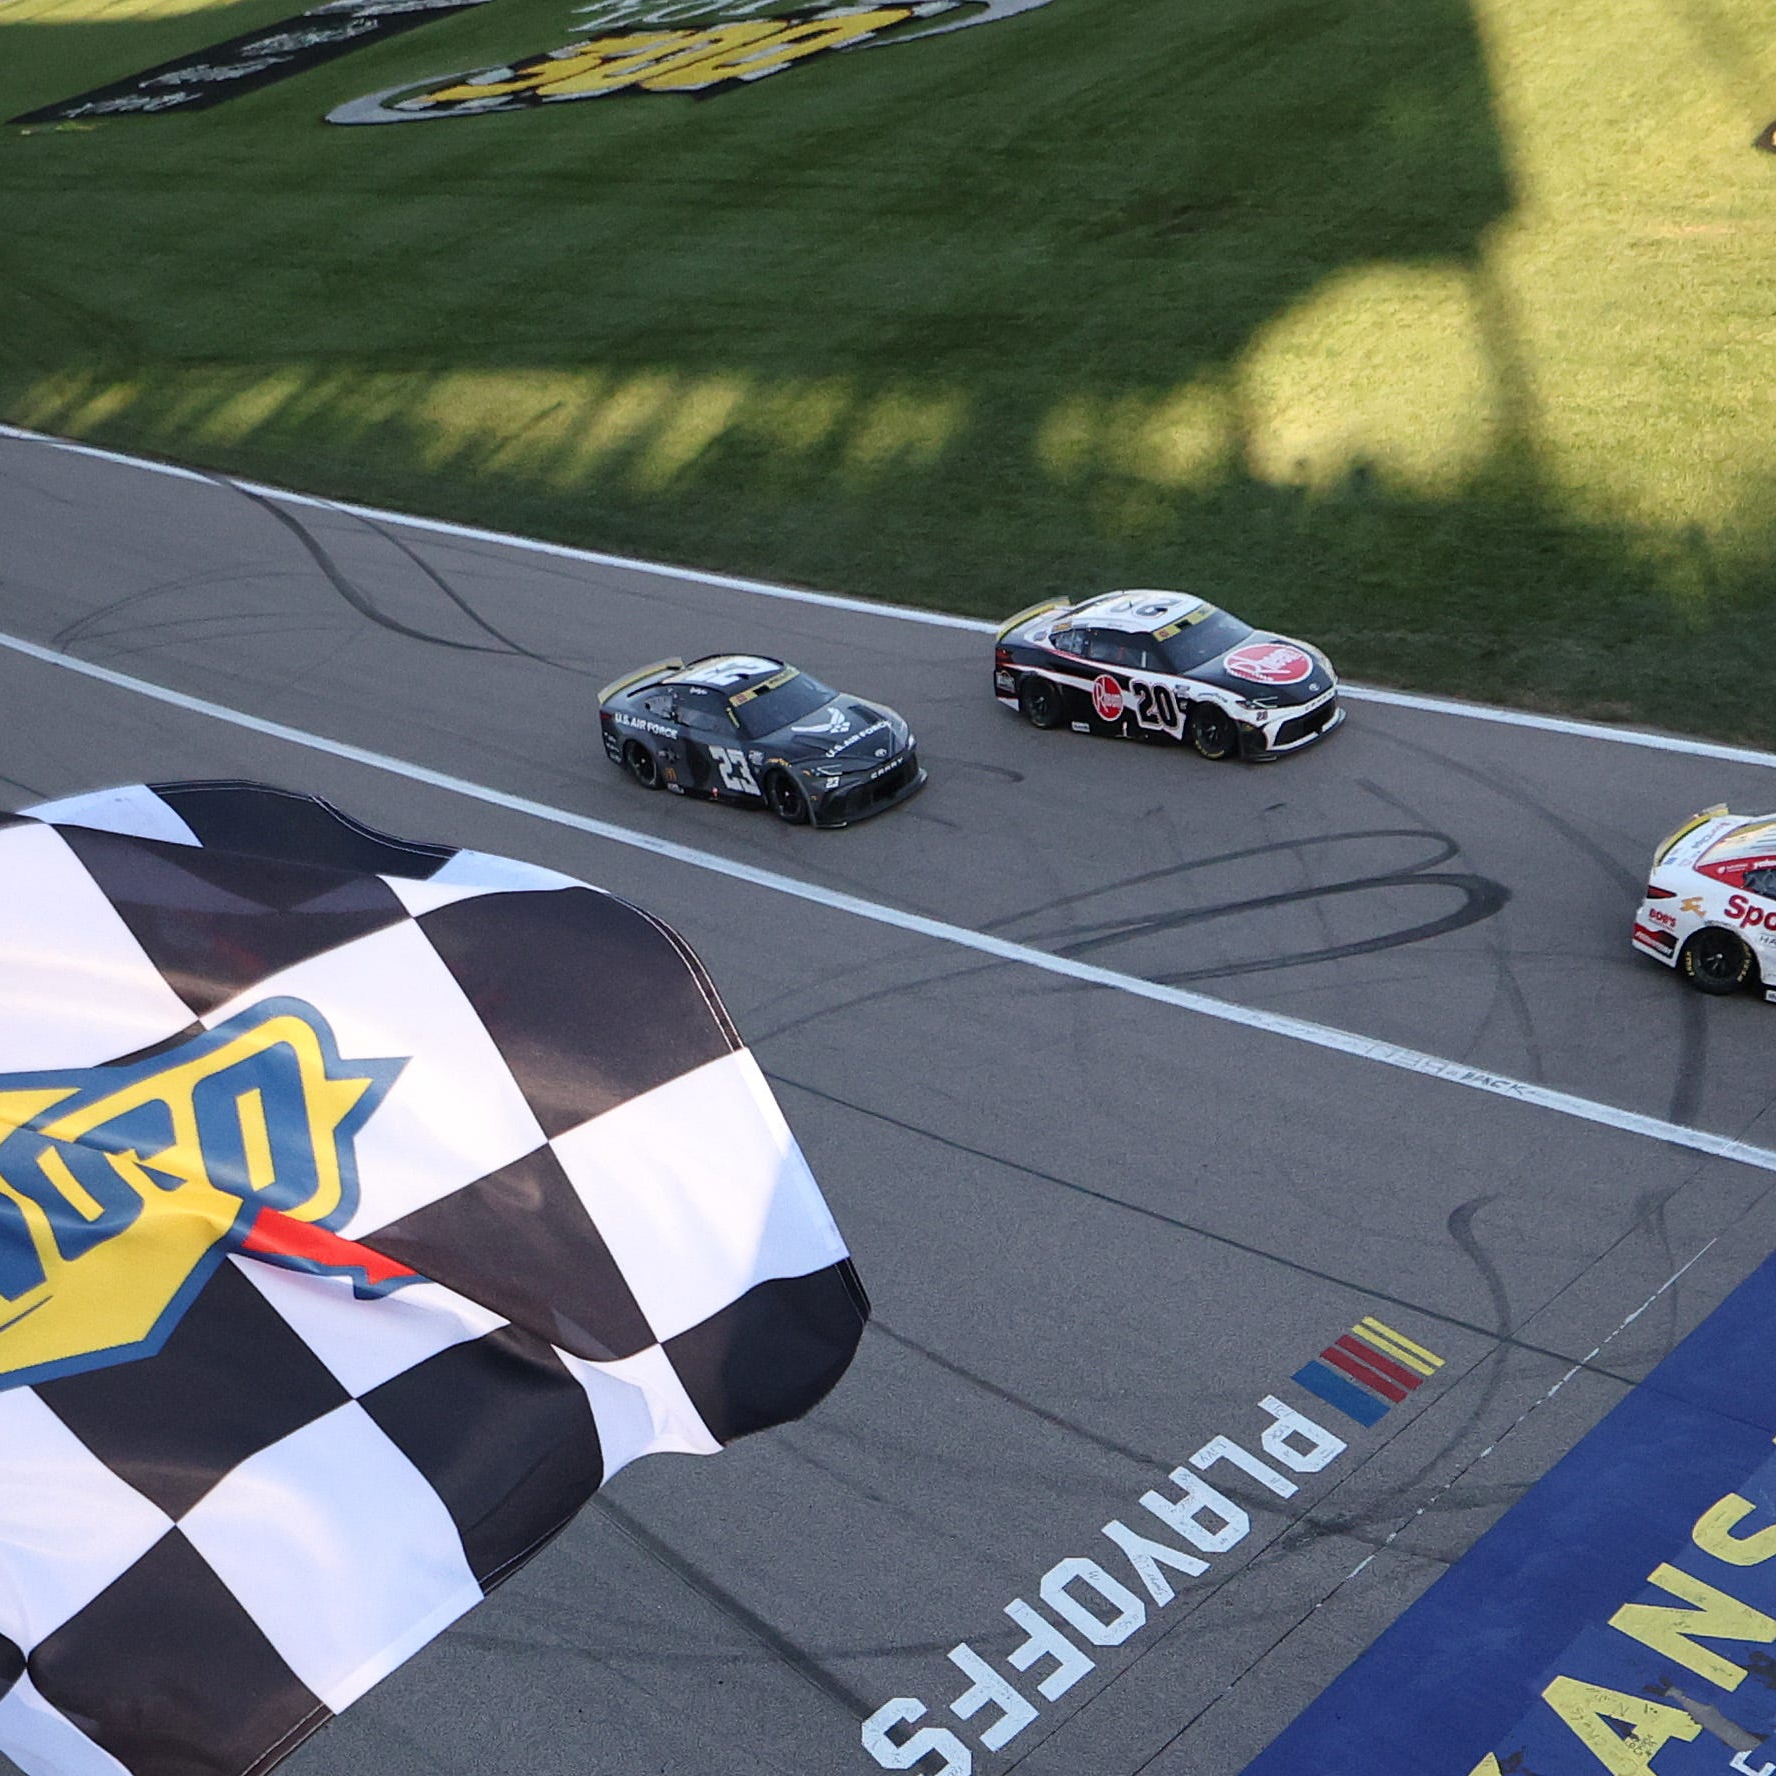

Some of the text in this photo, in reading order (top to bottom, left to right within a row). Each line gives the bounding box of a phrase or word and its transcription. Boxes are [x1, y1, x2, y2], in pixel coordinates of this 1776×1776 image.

[1131, 680, 1178, 728] 20
[630, 716, 646, 731] AIR
[647, 722, 678, 740] FORCE
[841, 734, 858, 749] AIR
[708, 745, 762, 796] 23
